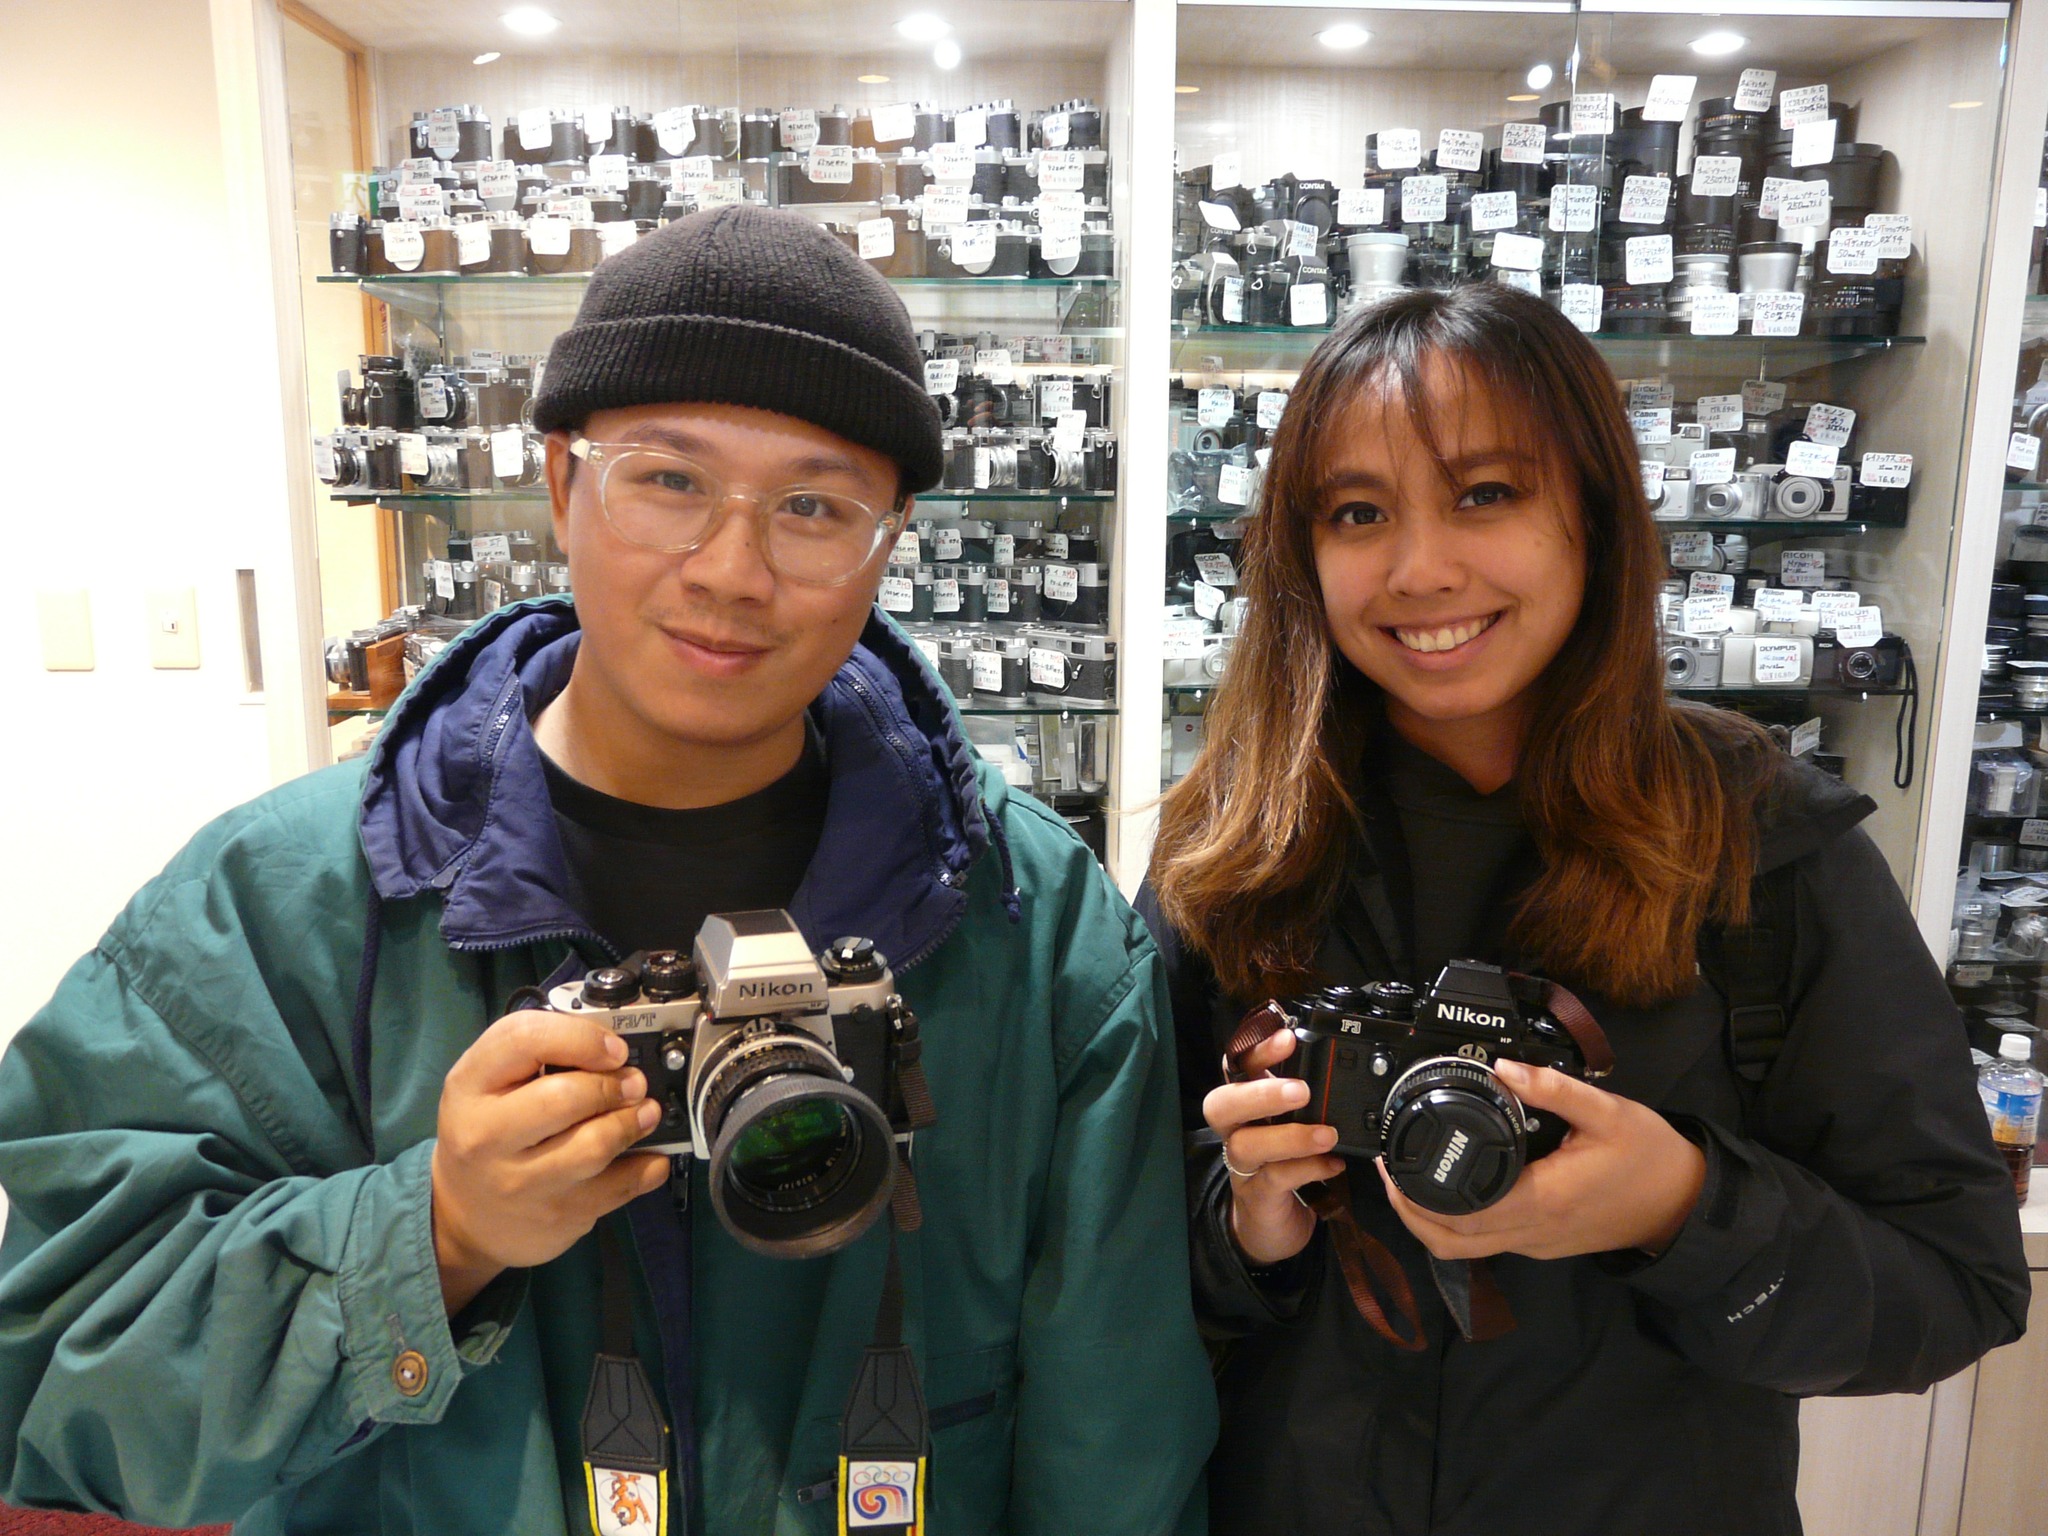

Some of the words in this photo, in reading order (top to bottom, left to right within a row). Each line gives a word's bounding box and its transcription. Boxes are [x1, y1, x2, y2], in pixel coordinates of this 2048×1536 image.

[1302, 266, 1328, 275] CONTAX
[1633, 410, 1659, 418] Canon
[1688, 596, 1727, 604] OLYMPUS
[738, 979, 814, 1000] Nikon
[612, 1012, 656, 1030] F3/T
[1437, 1003, 1506, 1029] Nikon
[1341, 1019, 1361, 1034] F3
[1500, 1036, 1512, 1044] HP
[1504, 1106, 1522, 1136] Nikon
[1433, 1129, 1469, 1184] Nikon
